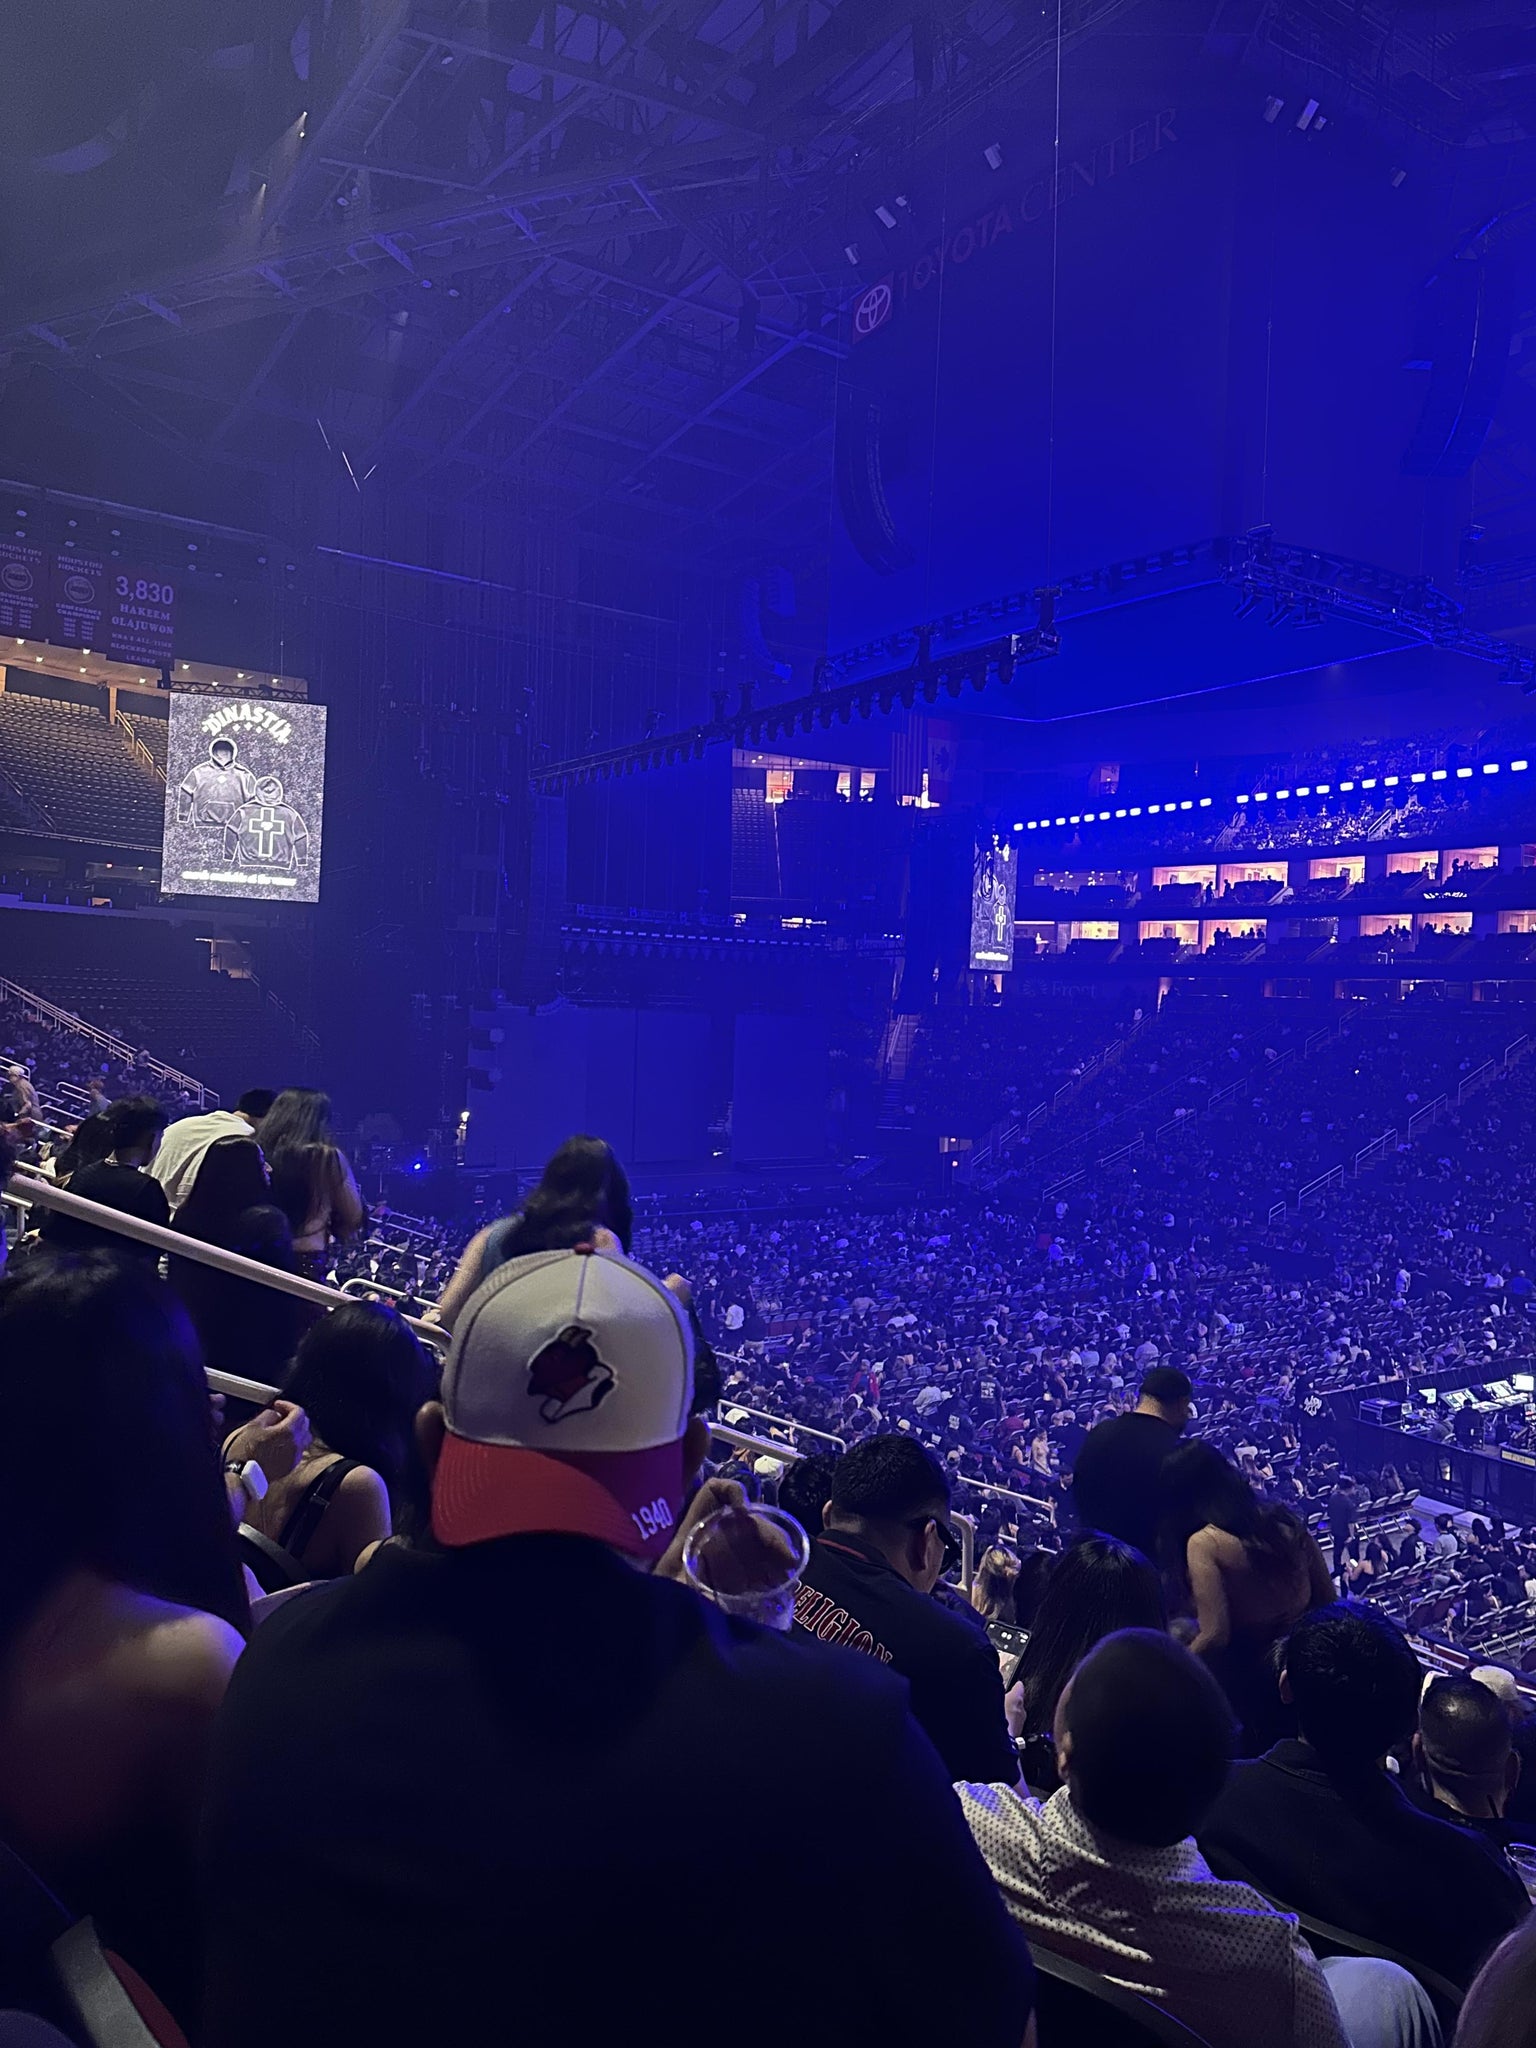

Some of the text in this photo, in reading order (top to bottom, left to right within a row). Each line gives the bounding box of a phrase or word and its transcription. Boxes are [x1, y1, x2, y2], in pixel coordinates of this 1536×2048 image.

[898, 107, 1179, 299] TOYOTA CENTER
[116, 576, 174, 605] 3,830
[111, 616, 175, 635] OLAJUWON
[119, 603, 171, 621] HAKEEM
[631, 1497, 673, 1541] 1940
